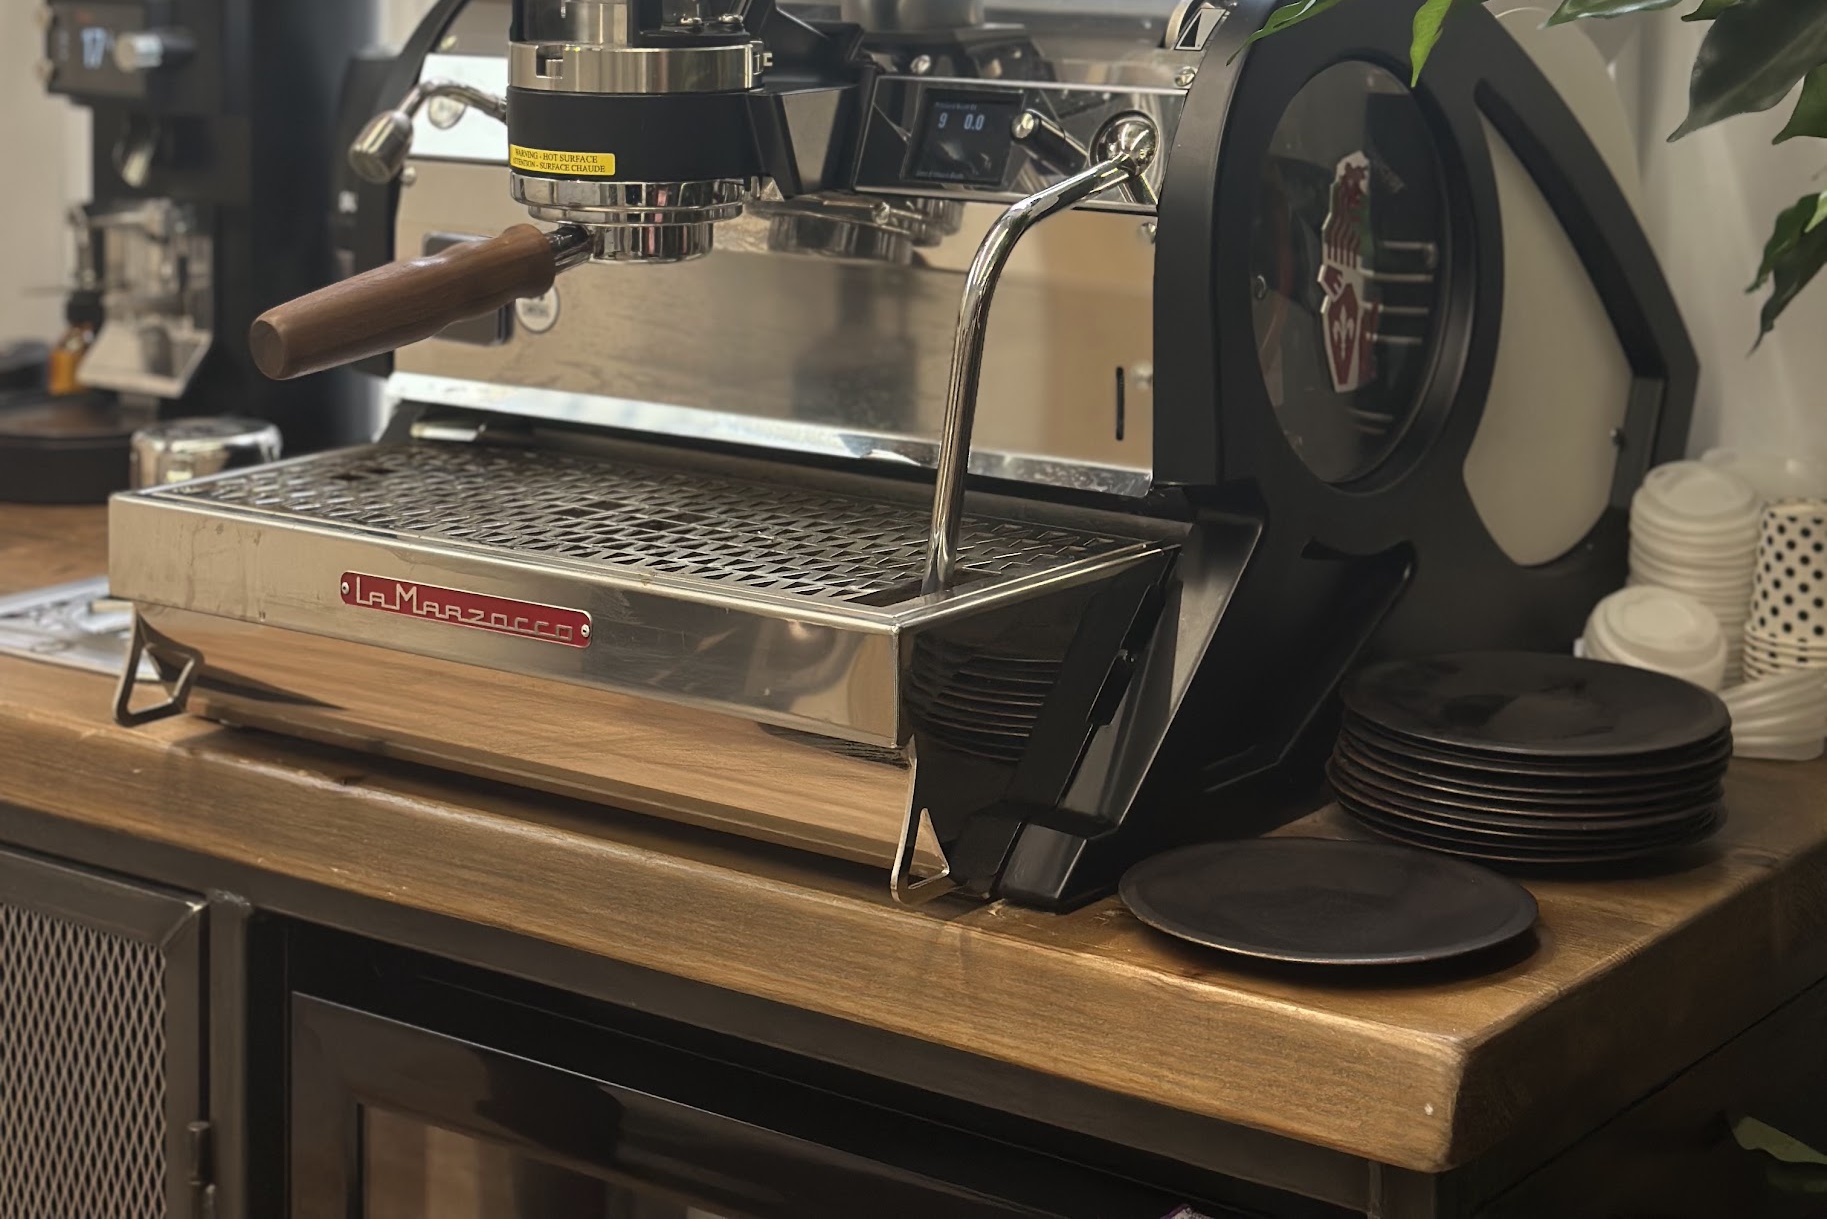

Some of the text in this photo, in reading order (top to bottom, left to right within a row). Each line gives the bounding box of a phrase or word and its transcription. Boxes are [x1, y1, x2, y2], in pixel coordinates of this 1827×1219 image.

[938, 113, 985, 131] 9 0.0
[543, 153, 558, 162] HOT
[559, 154, 598, 163] SURFACE
[539, 162, 570, 171] SURFACE
[571, 164, 605, 173] CHAUDE
